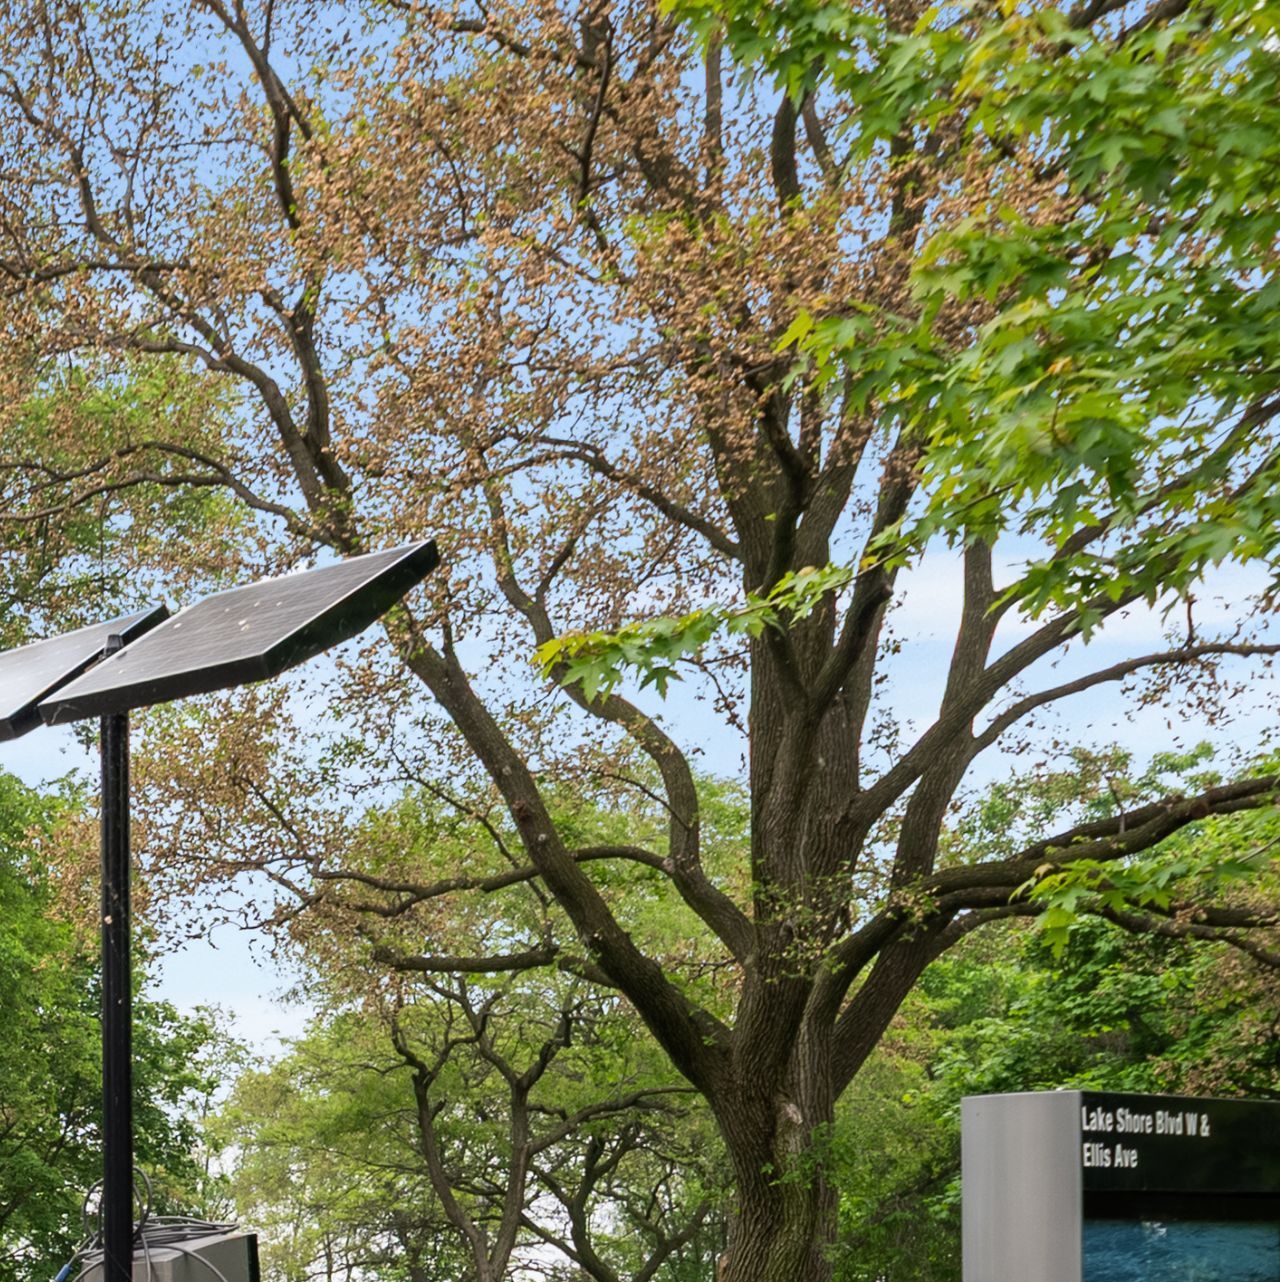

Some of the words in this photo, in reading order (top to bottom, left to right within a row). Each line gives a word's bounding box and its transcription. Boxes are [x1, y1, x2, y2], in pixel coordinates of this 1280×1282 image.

[1081, 1106, 1113, 1132] Lake
[1116, 1107, 1153, 1133] Shore
[1155, 1110, 1183, 1135] Blvd
[1185, 1112, 1197, 1136] W
[1200, 1113, 1210, 1137] &
[1083, 1142, 1111, 1167] Ellis
[1114, 1143, 1138, 1168] Ave
